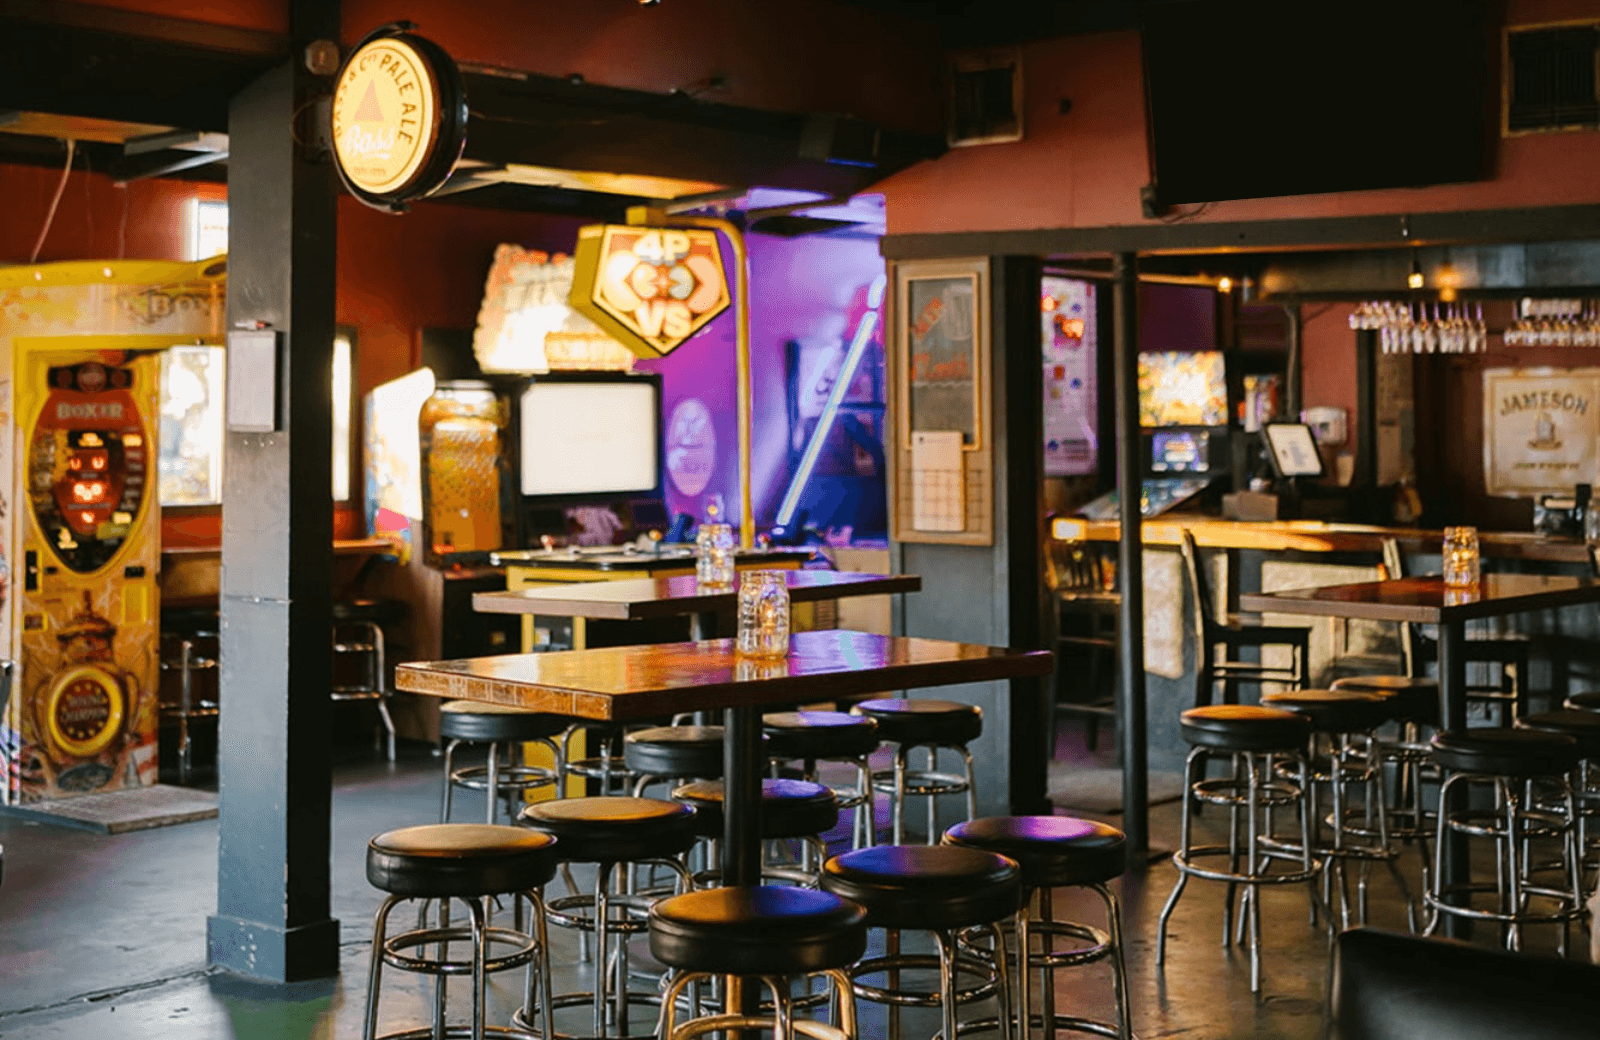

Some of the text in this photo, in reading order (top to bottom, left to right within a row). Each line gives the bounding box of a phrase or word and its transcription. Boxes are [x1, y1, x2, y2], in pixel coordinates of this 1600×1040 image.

[379, 53, 415, 96] PALE
[397, 102, 417, 145] ALE
[633, 232, 691, 265] 4P
[635, 301, 693, 338] VS
[1500, 390, 1589, 416] JAMESON
